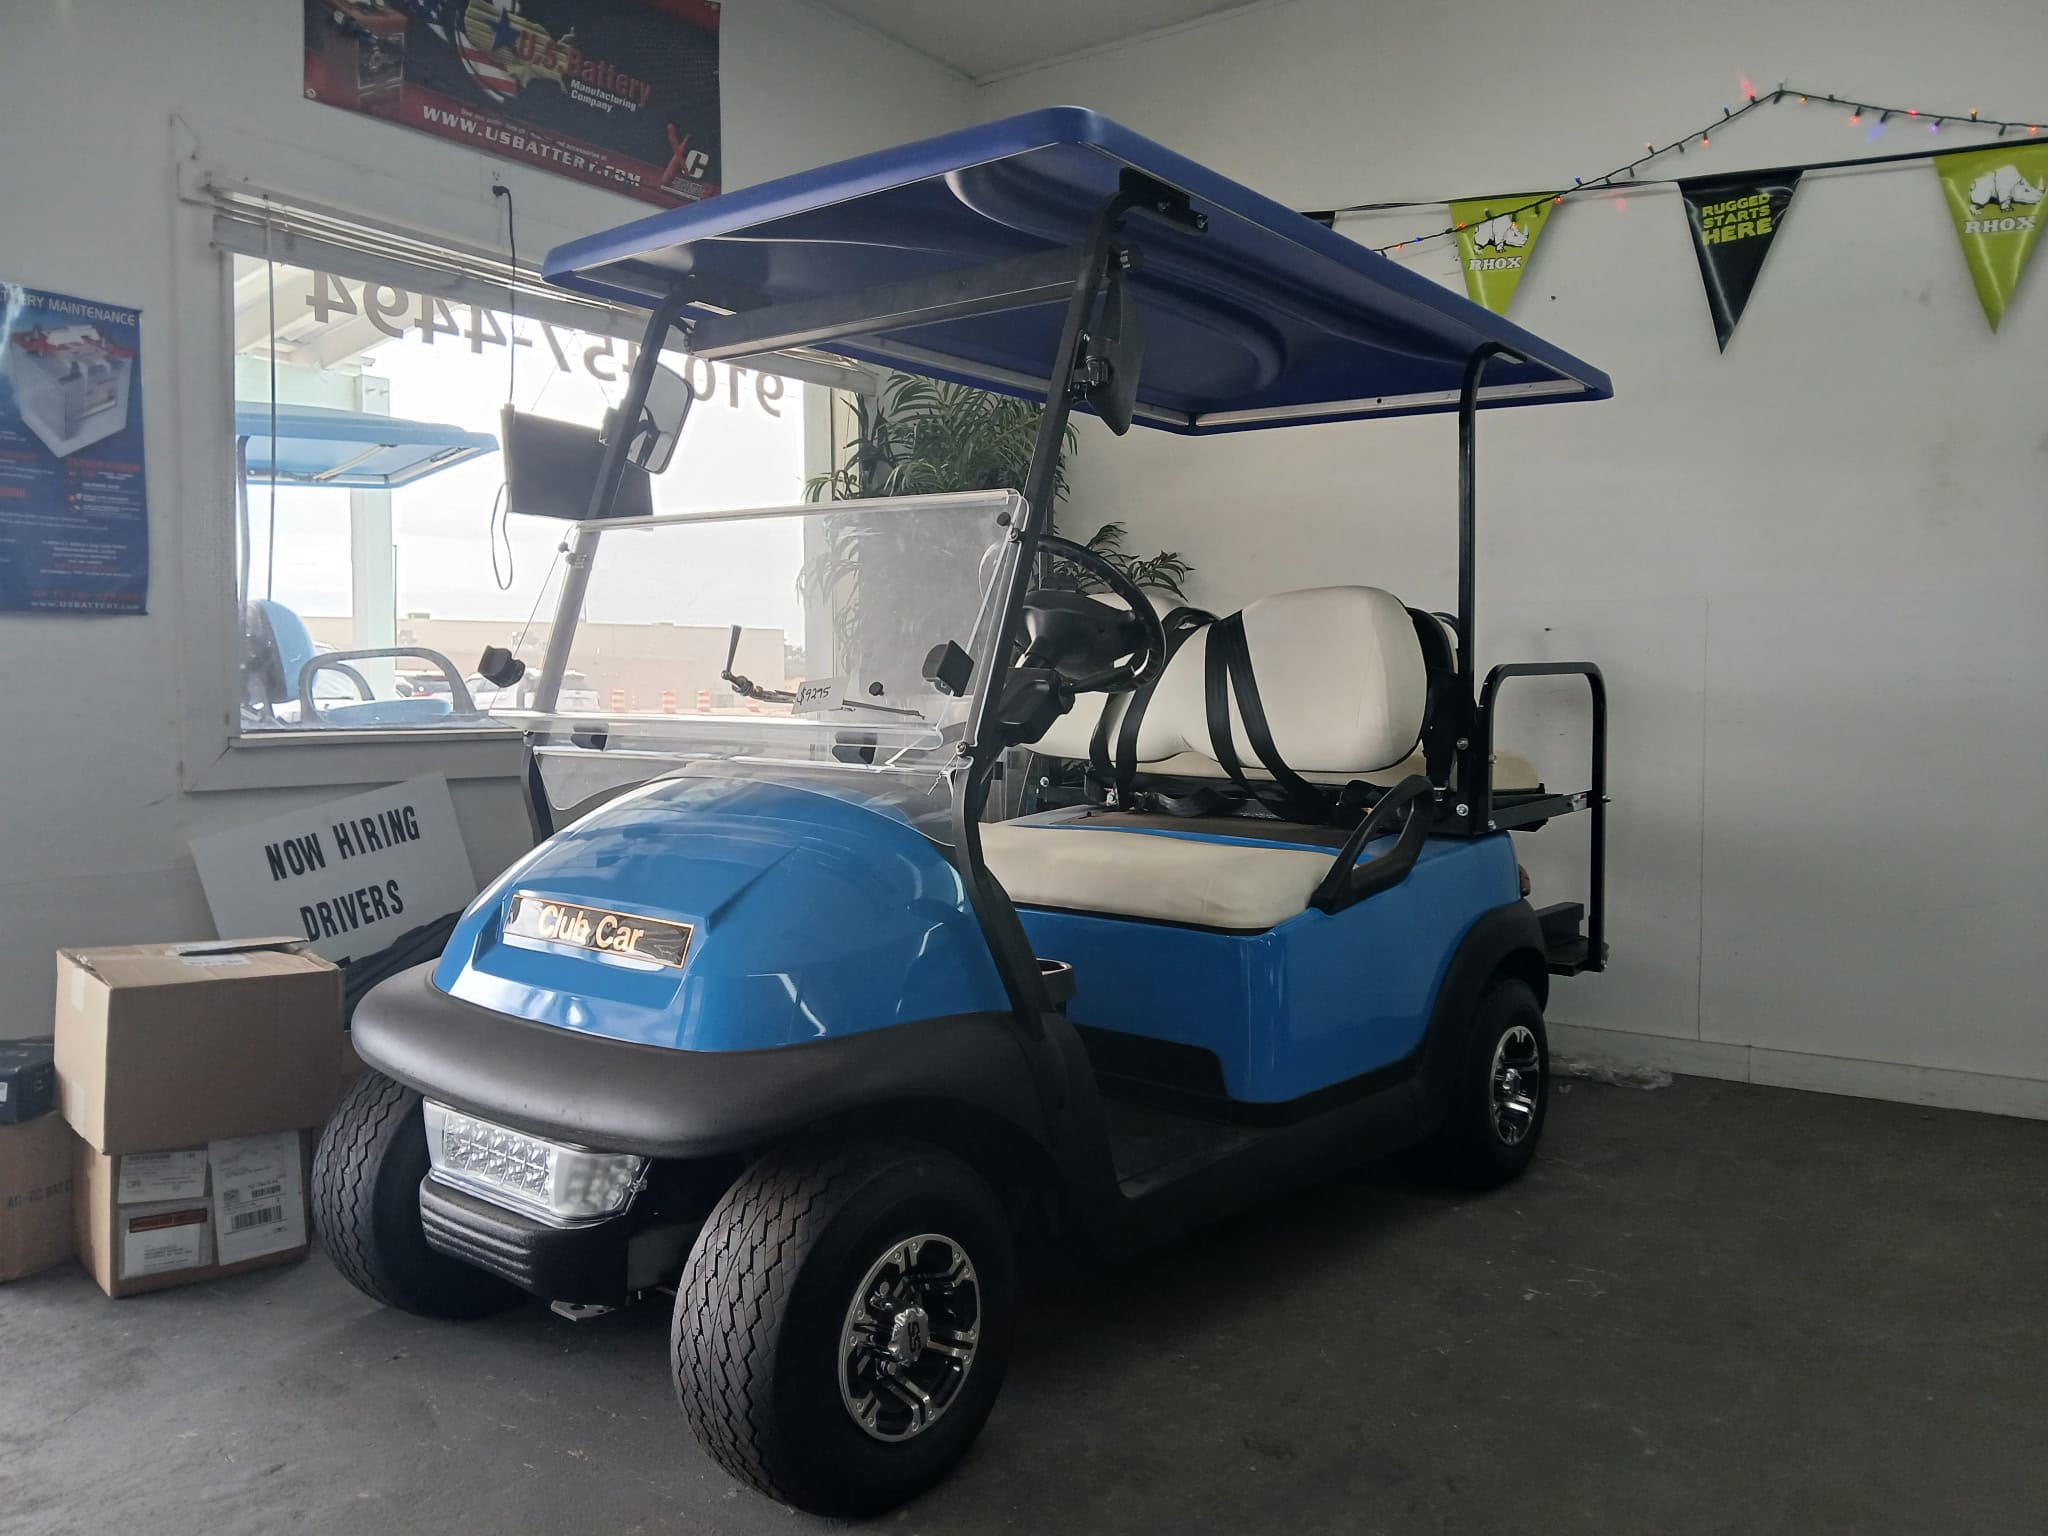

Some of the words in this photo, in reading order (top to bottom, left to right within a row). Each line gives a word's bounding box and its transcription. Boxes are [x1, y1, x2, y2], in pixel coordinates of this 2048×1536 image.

[567, 47, 655, 107] Battery
[570, 78, 637, 112] Manufacturing
[571, 89, 613, 113] Company
[1702, 192, 1771, 217] RUGGED
[1703, 204, 1771, 229] STARTS
[1702, 217, 1772, 246] HERE
[1965, 215, 2037, 234] RHOX
[1469, 256, 1522, 271] RHOX
[48, 299, 135, 326] MAINTENANCE
[264, 832, 327, 881] NOW
[332, 805, 421, 861] HIRING
[300, 879, 404, 943] DRIVERS
[537, 904, 591, 947] Club
[595, 914, 645, 952] Car
